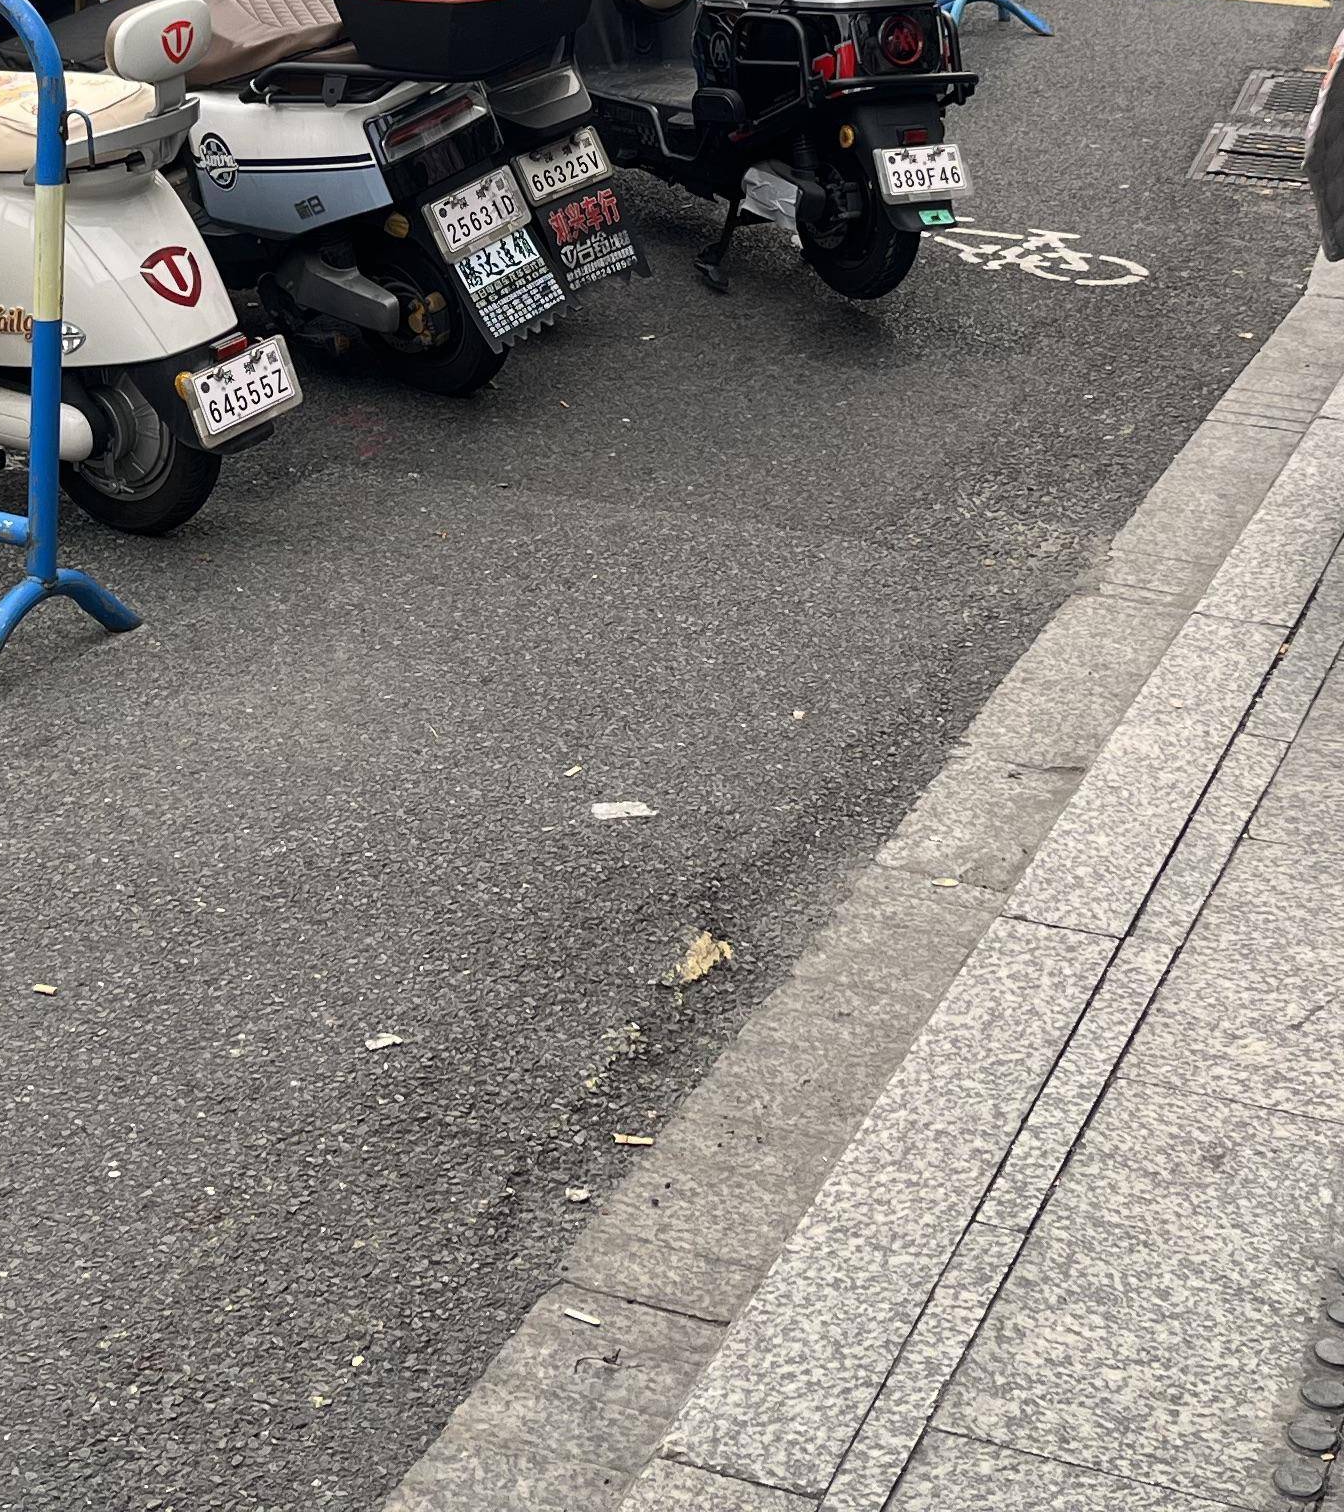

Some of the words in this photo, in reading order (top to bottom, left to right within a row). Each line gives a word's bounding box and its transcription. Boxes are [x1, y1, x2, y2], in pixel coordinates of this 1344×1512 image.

[531, 150, 600, 193] 66325V
[892, 166, 961, 189] 389F46
[446, 194, 516, 245] 25631D
[209, 368, 288, 423] 64555Z
